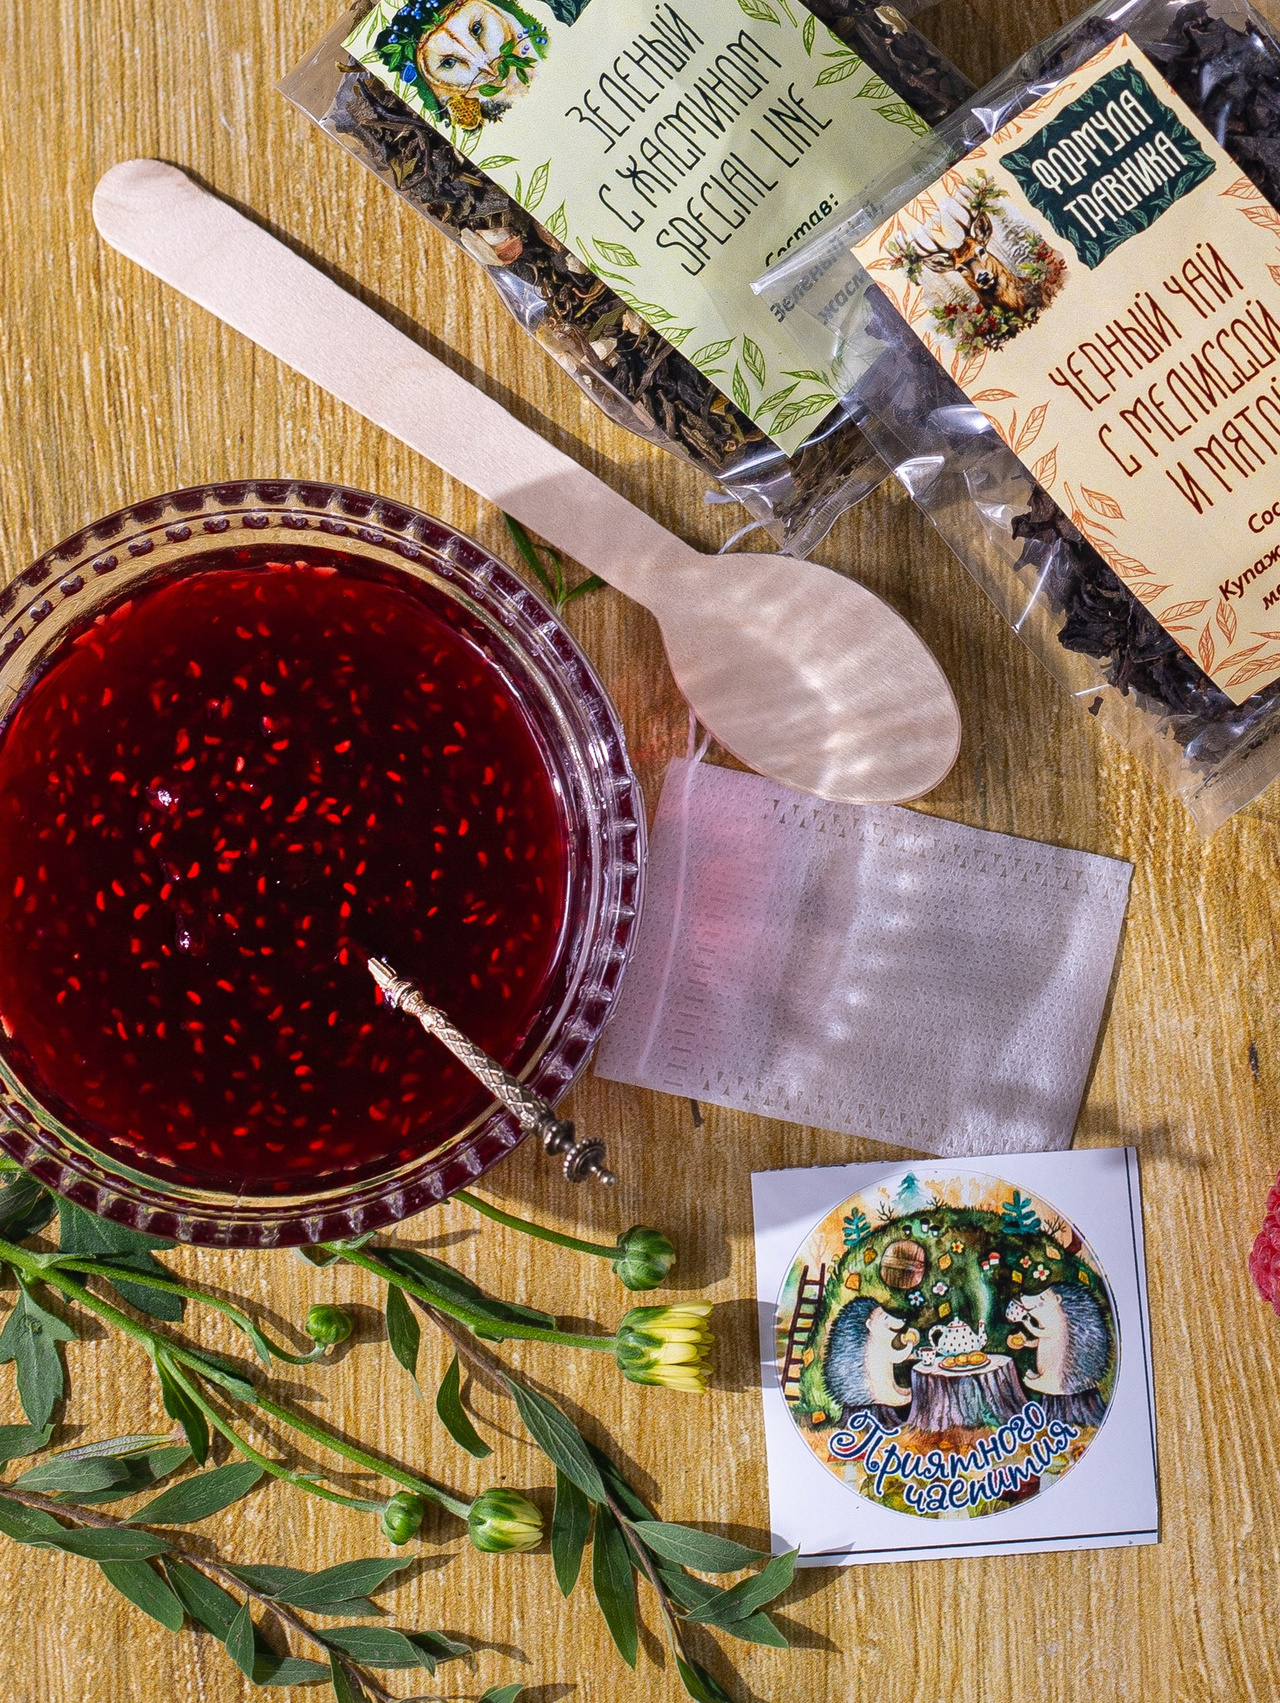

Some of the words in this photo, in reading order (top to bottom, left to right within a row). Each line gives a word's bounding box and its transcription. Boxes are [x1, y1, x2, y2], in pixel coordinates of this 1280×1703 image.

[565, 2, 705, 155] ЗЕЛЕНЫЙ
[615, 29, 782, 210] ЖАСМИНОМ
[656, 151, 779, 276] SPECIAL
[750, 82, 834, 168] LINE
[1031, 90, 1152, 194] ФОРМУЛА
[1063, 131, 1188, 238] ТРАВНИКА
[598, 184, 644, 233] С
[1048, 291, 1182, 412] ЧЕРНЫЙ
[1163, 242, 1244, 319] ЧАЙ
[1098, 424, 1141, 477] С
[1166, 462, 1213, 515] И
[829, 1400, 1046, 1495] Приятного
[905, 1421, 1079, 1512] чаепития
